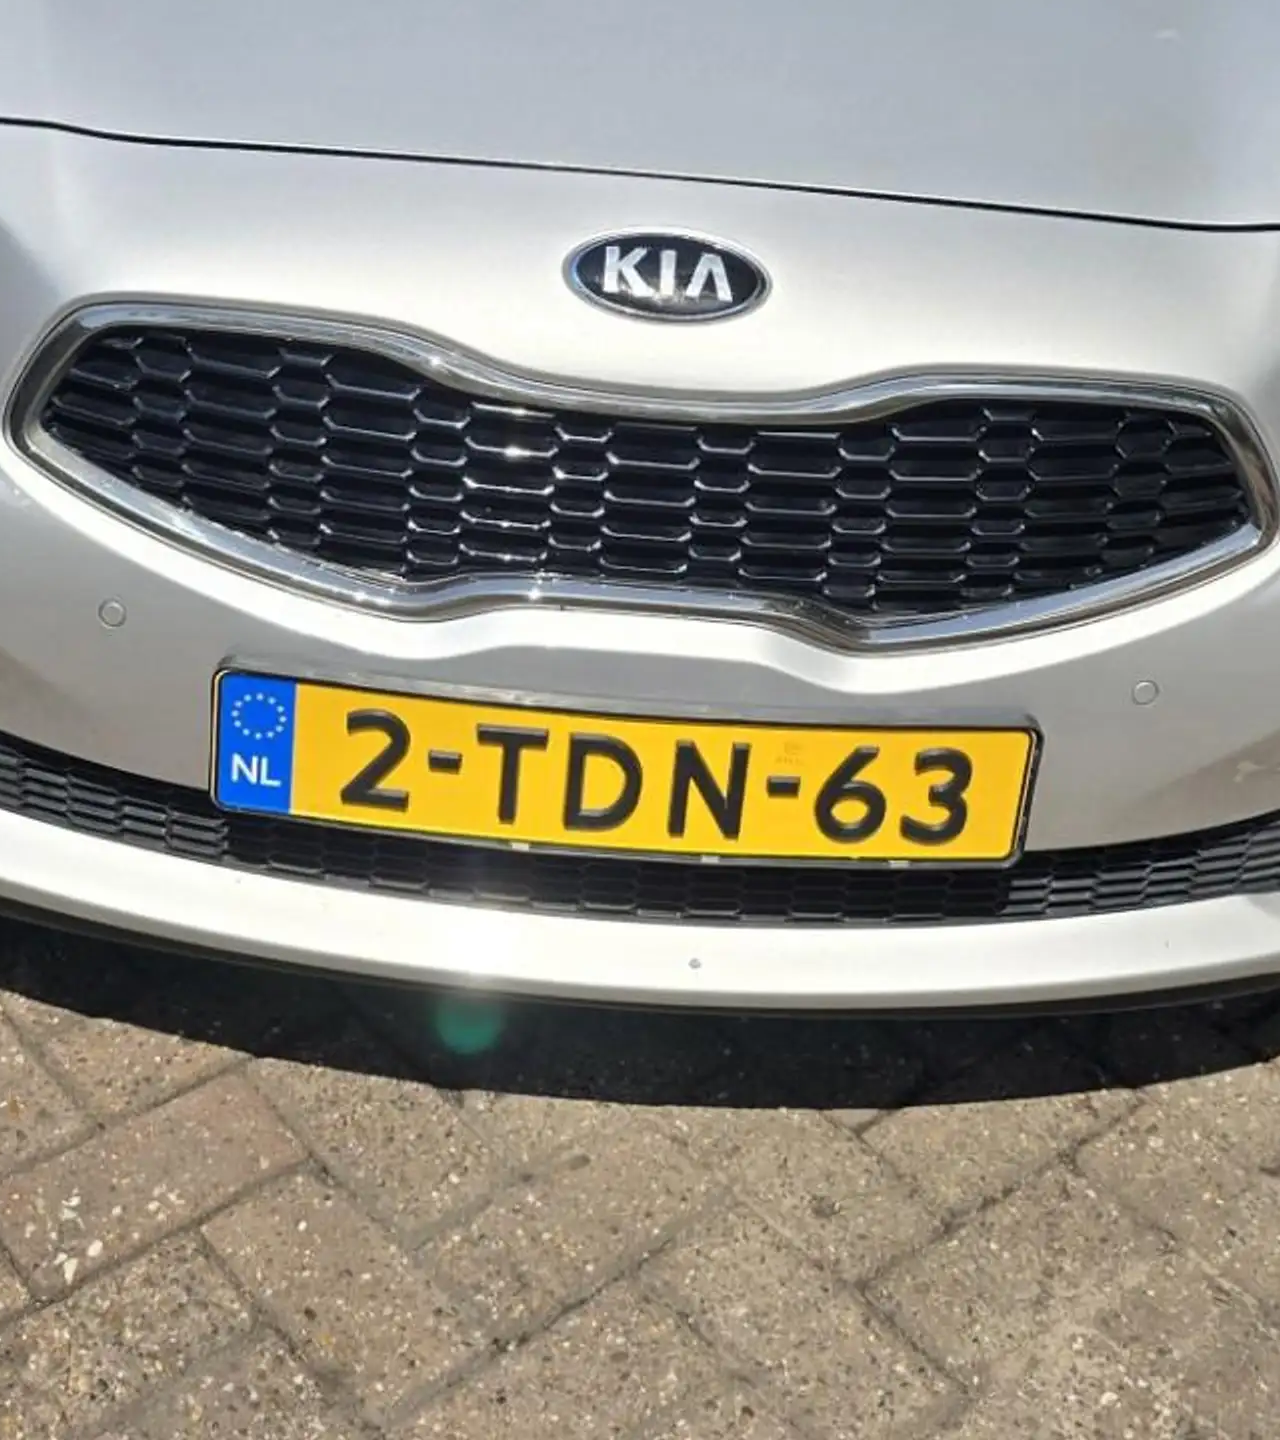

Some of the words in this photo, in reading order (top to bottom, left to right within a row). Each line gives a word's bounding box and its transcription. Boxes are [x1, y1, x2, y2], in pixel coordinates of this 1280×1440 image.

[602, 245, 733, 303] KIA
[231, 752, 281, 787] NL
[340, 708, 972, 846] 2-TDN-63
